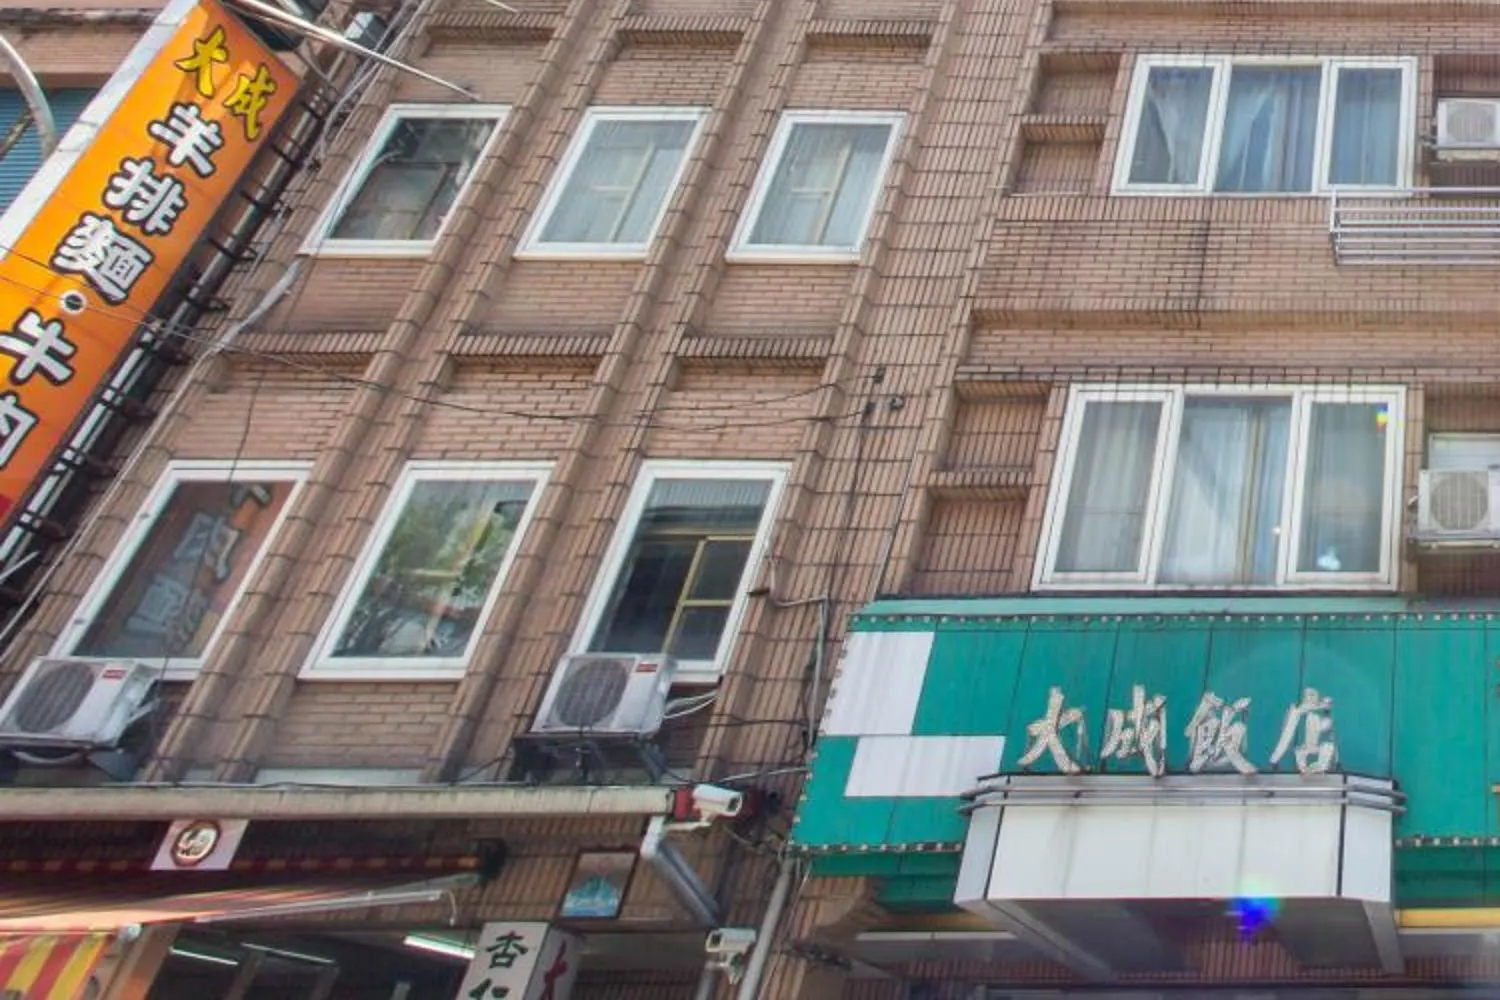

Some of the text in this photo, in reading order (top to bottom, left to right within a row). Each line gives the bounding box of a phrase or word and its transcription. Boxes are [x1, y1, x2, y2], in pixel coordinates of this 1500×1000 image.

[176, 25, 277, 142] 大成
[1017, 684, 1338, 777] 大成飯店
